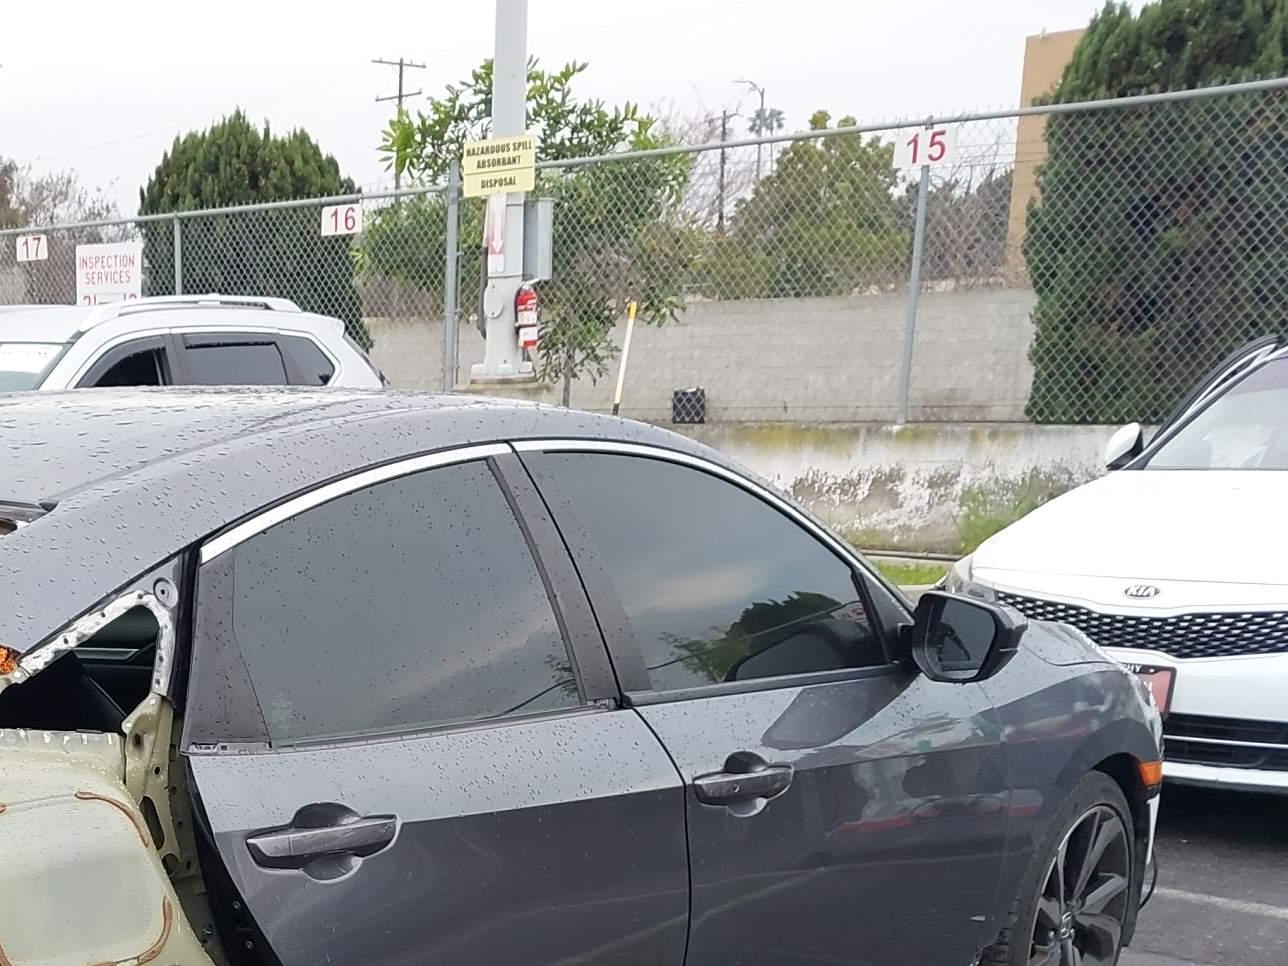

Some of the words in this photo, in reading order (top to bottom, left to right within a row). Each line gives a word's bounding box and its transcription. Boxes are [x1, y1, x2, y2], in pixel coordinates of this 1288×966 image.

[466, 142, 510, 157] HAZARDOUS
[511, 140, 532, 152] SPILL
[907, 130, 946, 164] 15
[476, 155, 522, 169] ABSORBANT
[480, 176, 516, 189] DISPOSAL
[330, 206, 356, 233] 16
[22, 236, 42, 259] 17
[79, 254, 136, 270] INSPECTION
[85, 270, 131, 285] SERVICES
[1126, 584, 1157, 598] KIA
